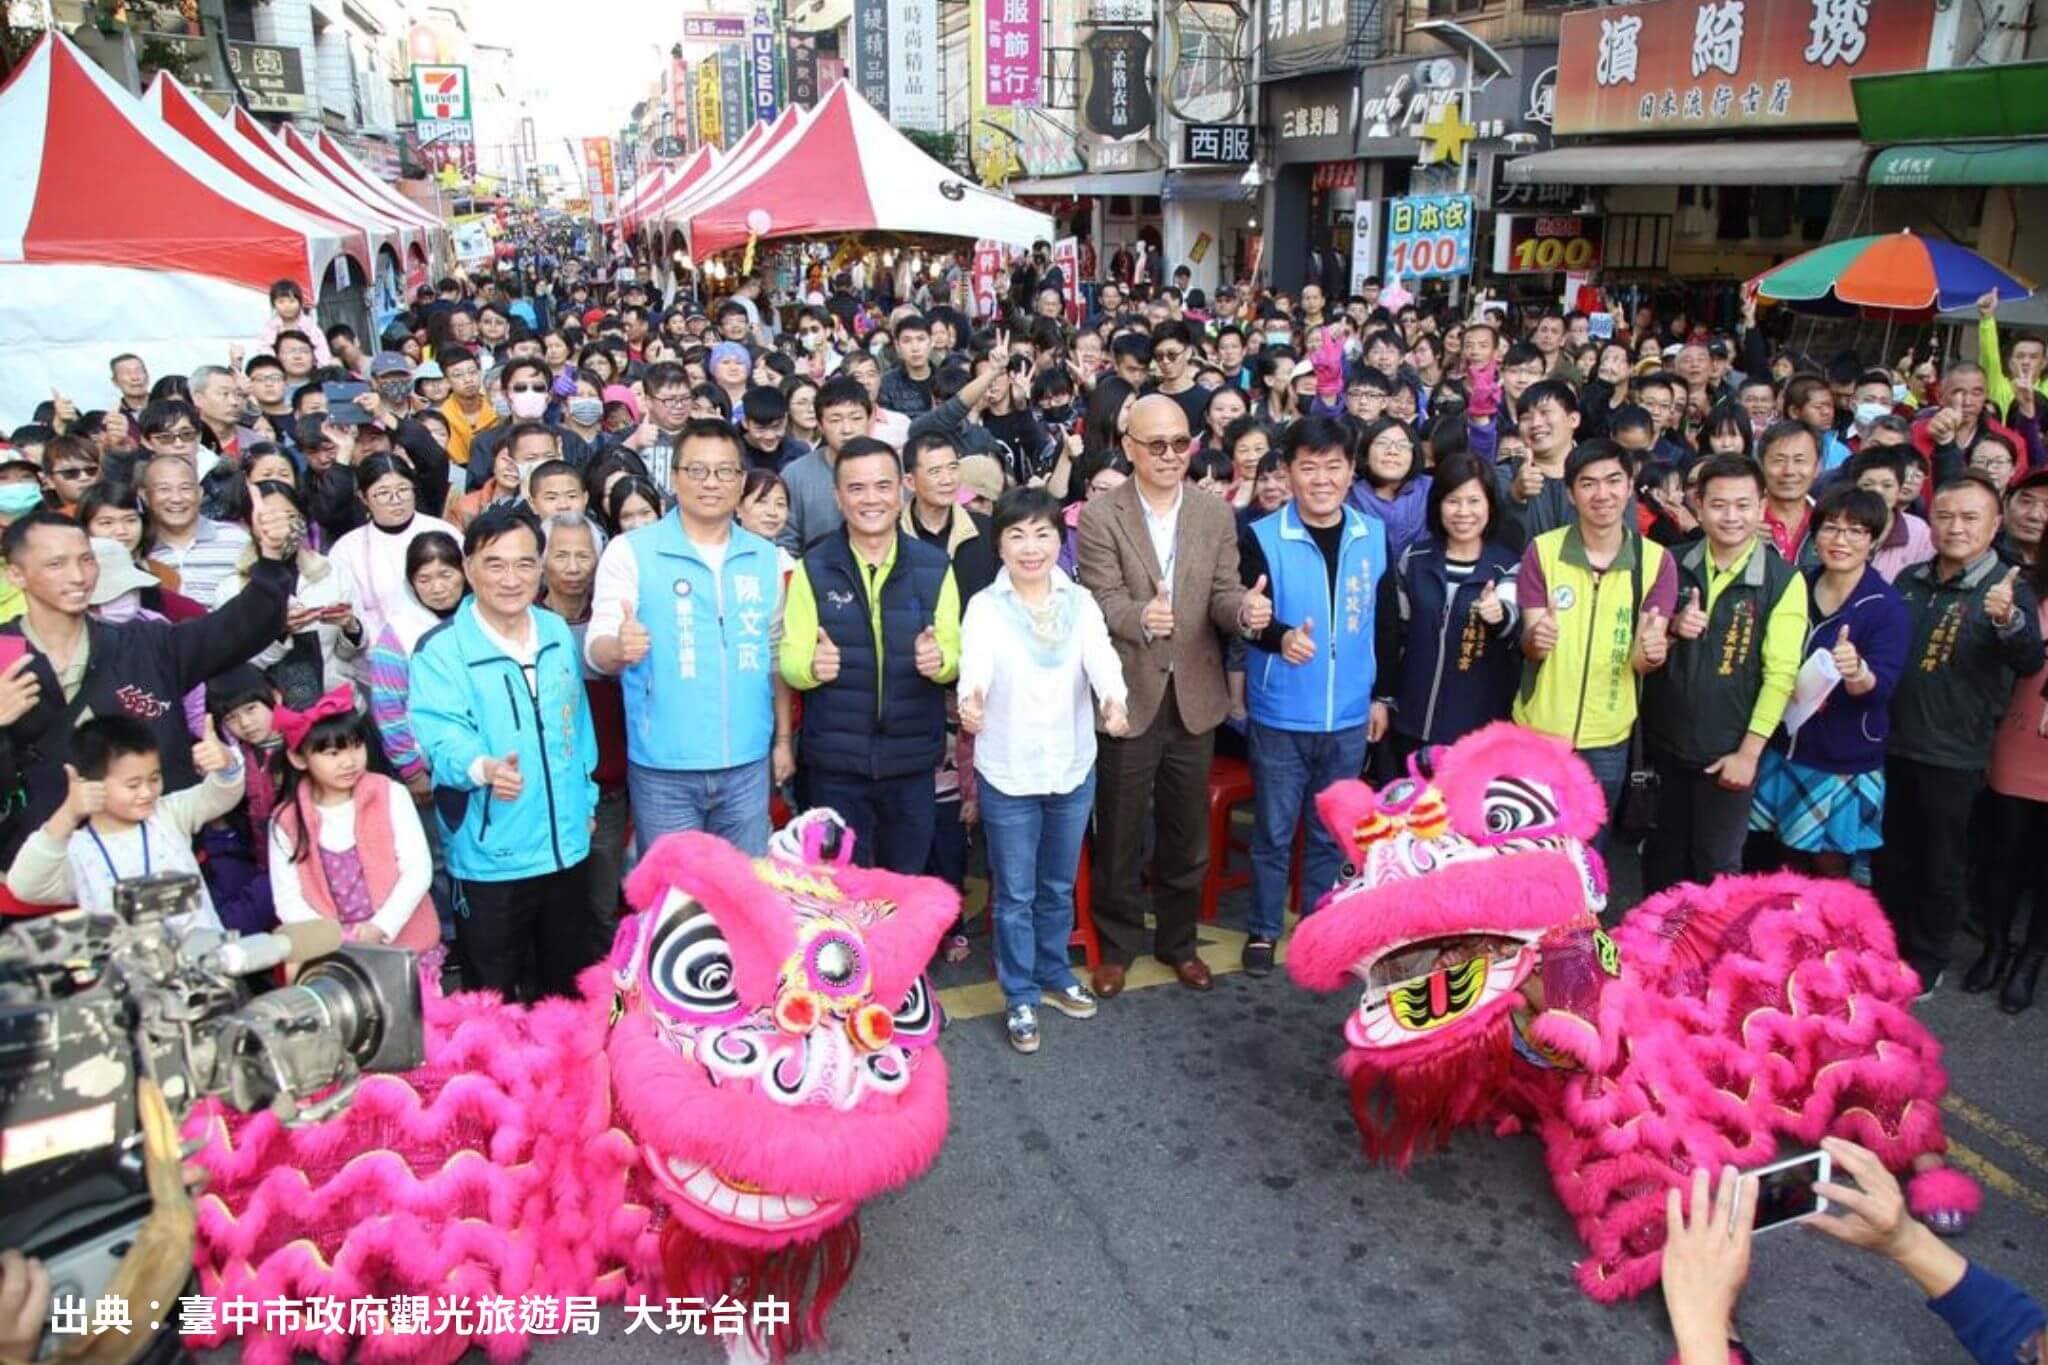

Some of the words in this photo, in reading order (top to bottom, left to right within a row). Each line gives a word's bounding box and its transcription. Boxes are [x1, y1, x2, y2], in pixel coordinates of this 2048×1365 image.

[755, 36, 774, 108] USED
[1190, 127, 1250, 161] 西服
[1392, 238, 1456, 274] 100
[1514, 238, 1595, 269] 100
